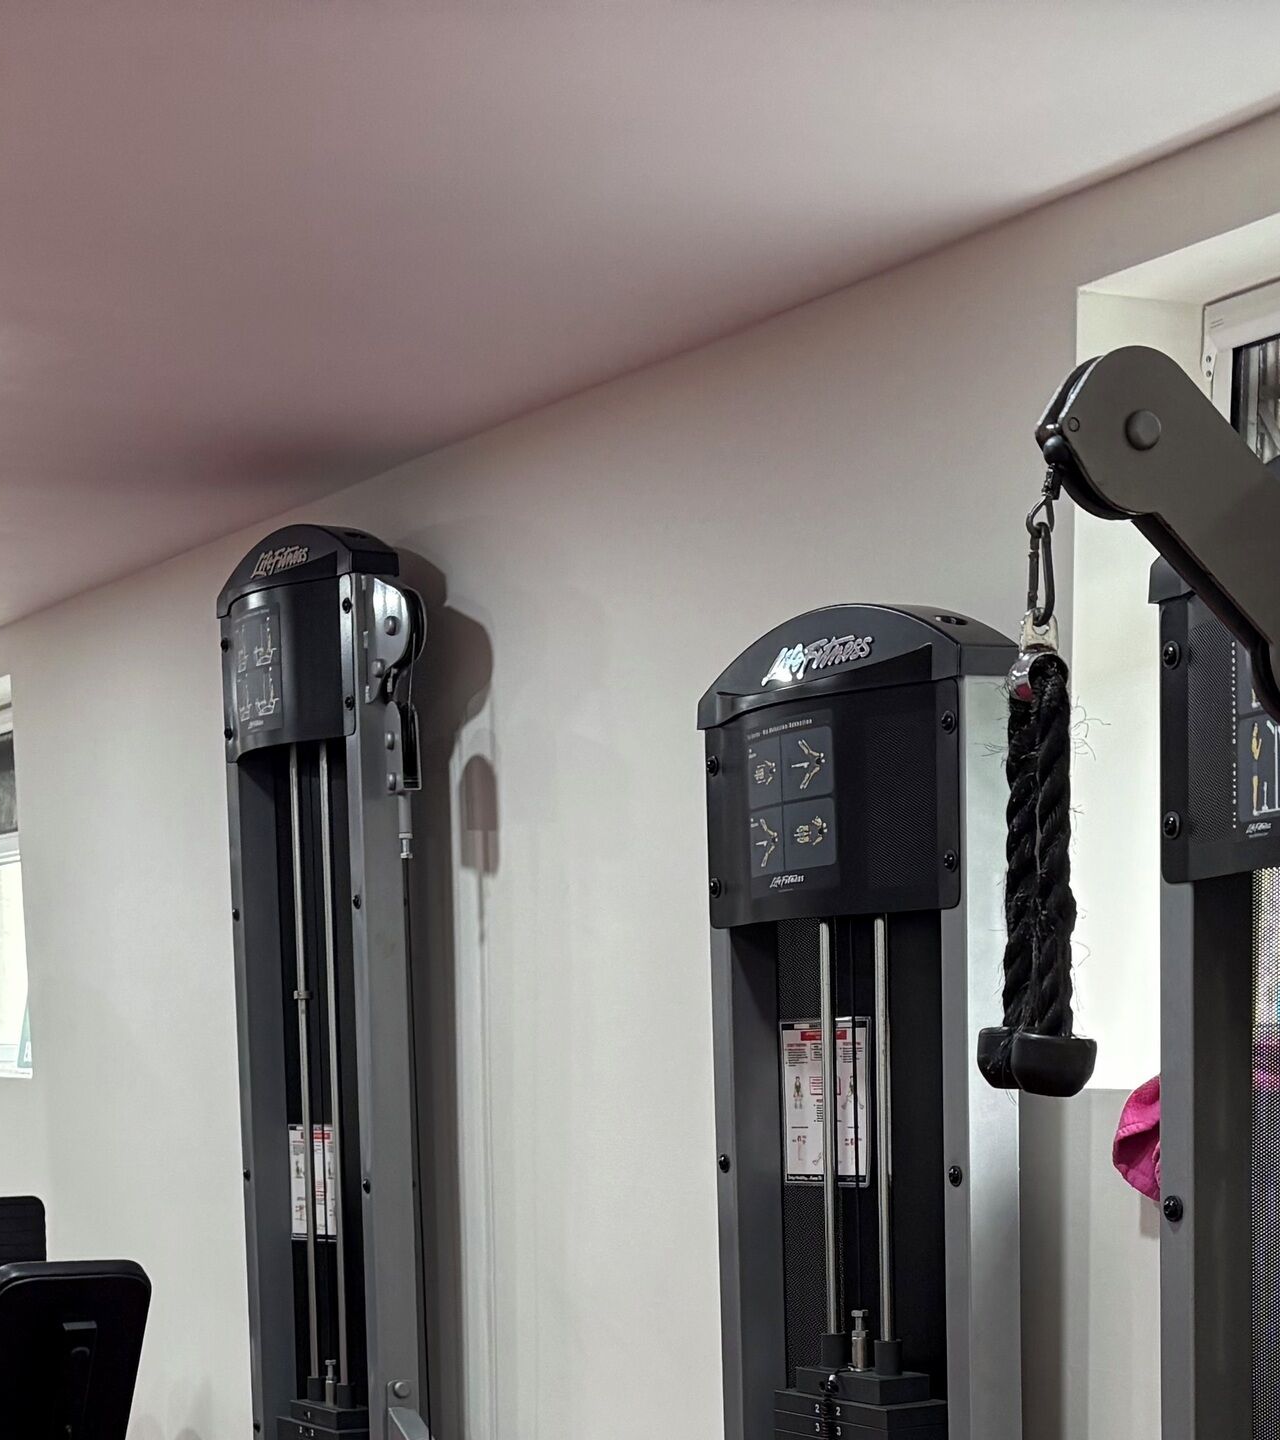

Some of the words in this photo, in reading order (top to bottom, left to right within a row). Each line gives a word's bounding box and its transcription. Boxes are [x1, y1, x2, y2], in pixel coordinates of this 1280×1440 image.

[814, 1403, 820, 1414] 2
[835, 1406, 841, 1416] 2
[815, 1422, 820, 1432] 3
[836, 1426, 842, 1436] 3
